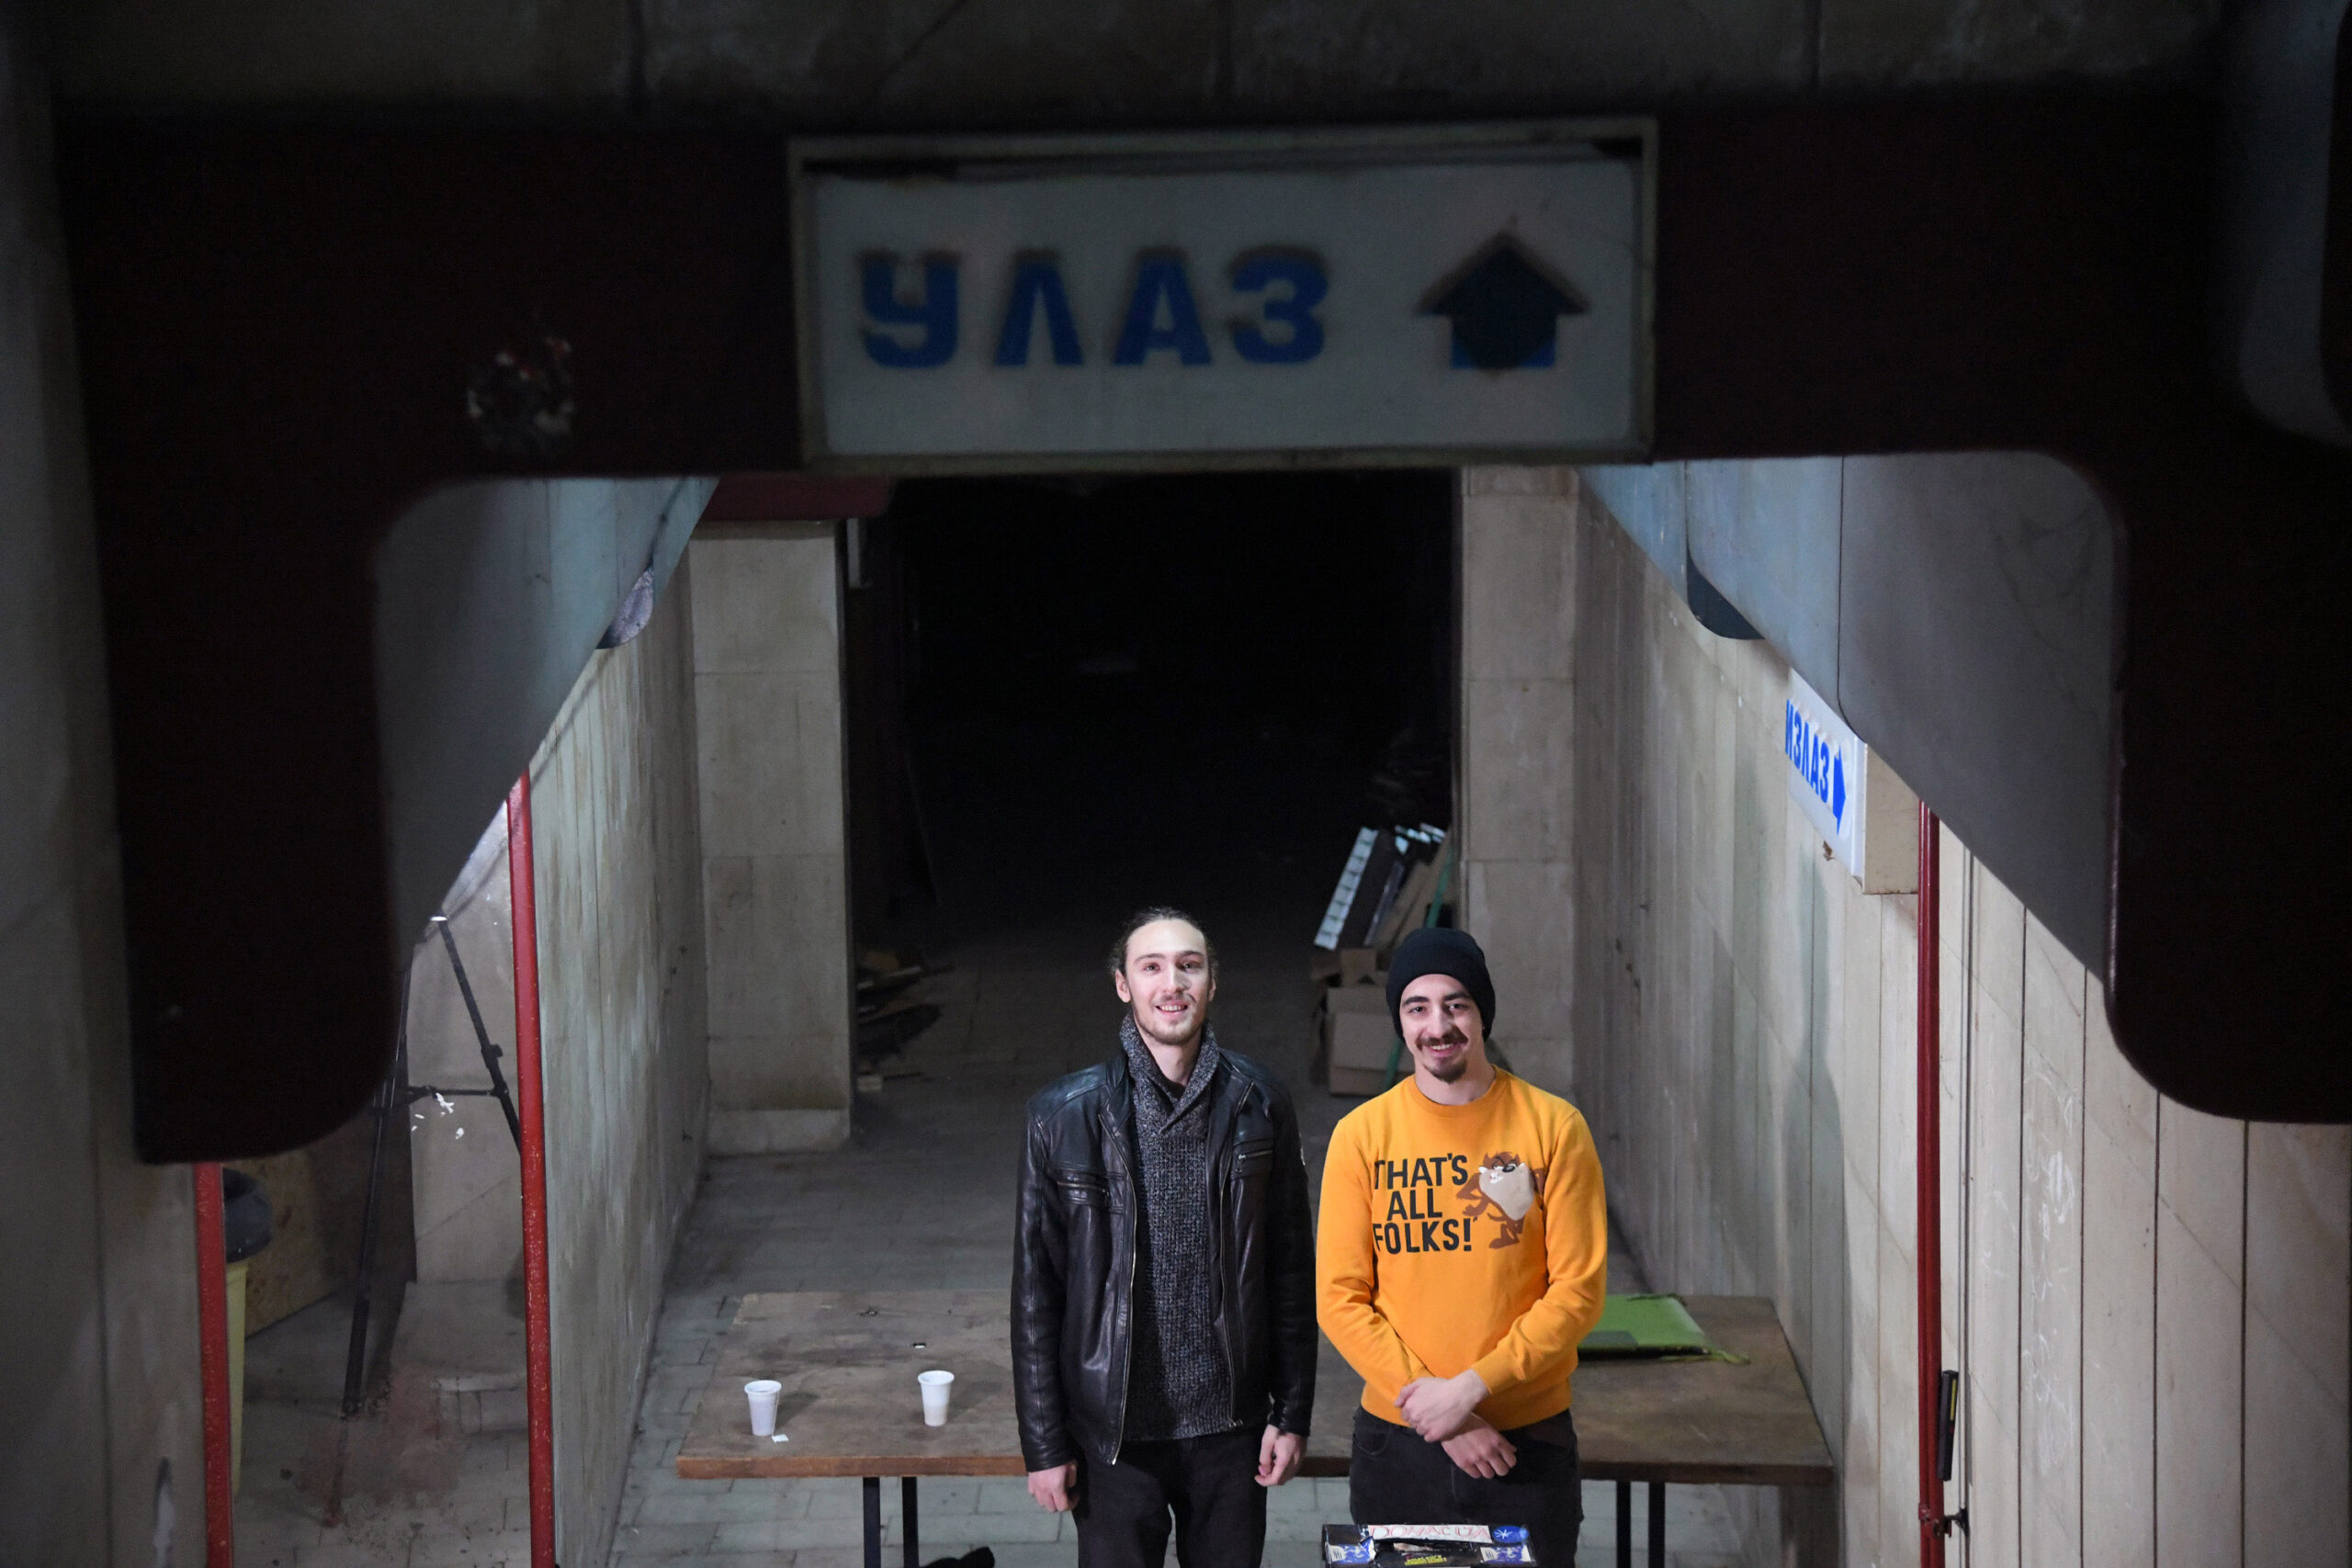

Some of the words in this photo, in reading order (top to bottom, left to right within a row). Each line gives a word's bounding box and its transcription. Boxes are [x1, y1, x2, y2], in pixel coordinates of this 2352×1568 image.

[856, 243, 1330, 367] УЛАЗ
[1785, 698, 1830, 804] ИЗЛАЗ
[1374, 1153, 1468, 1190] THAT'S
[1386, 1188, 1442, 1222] ALL
